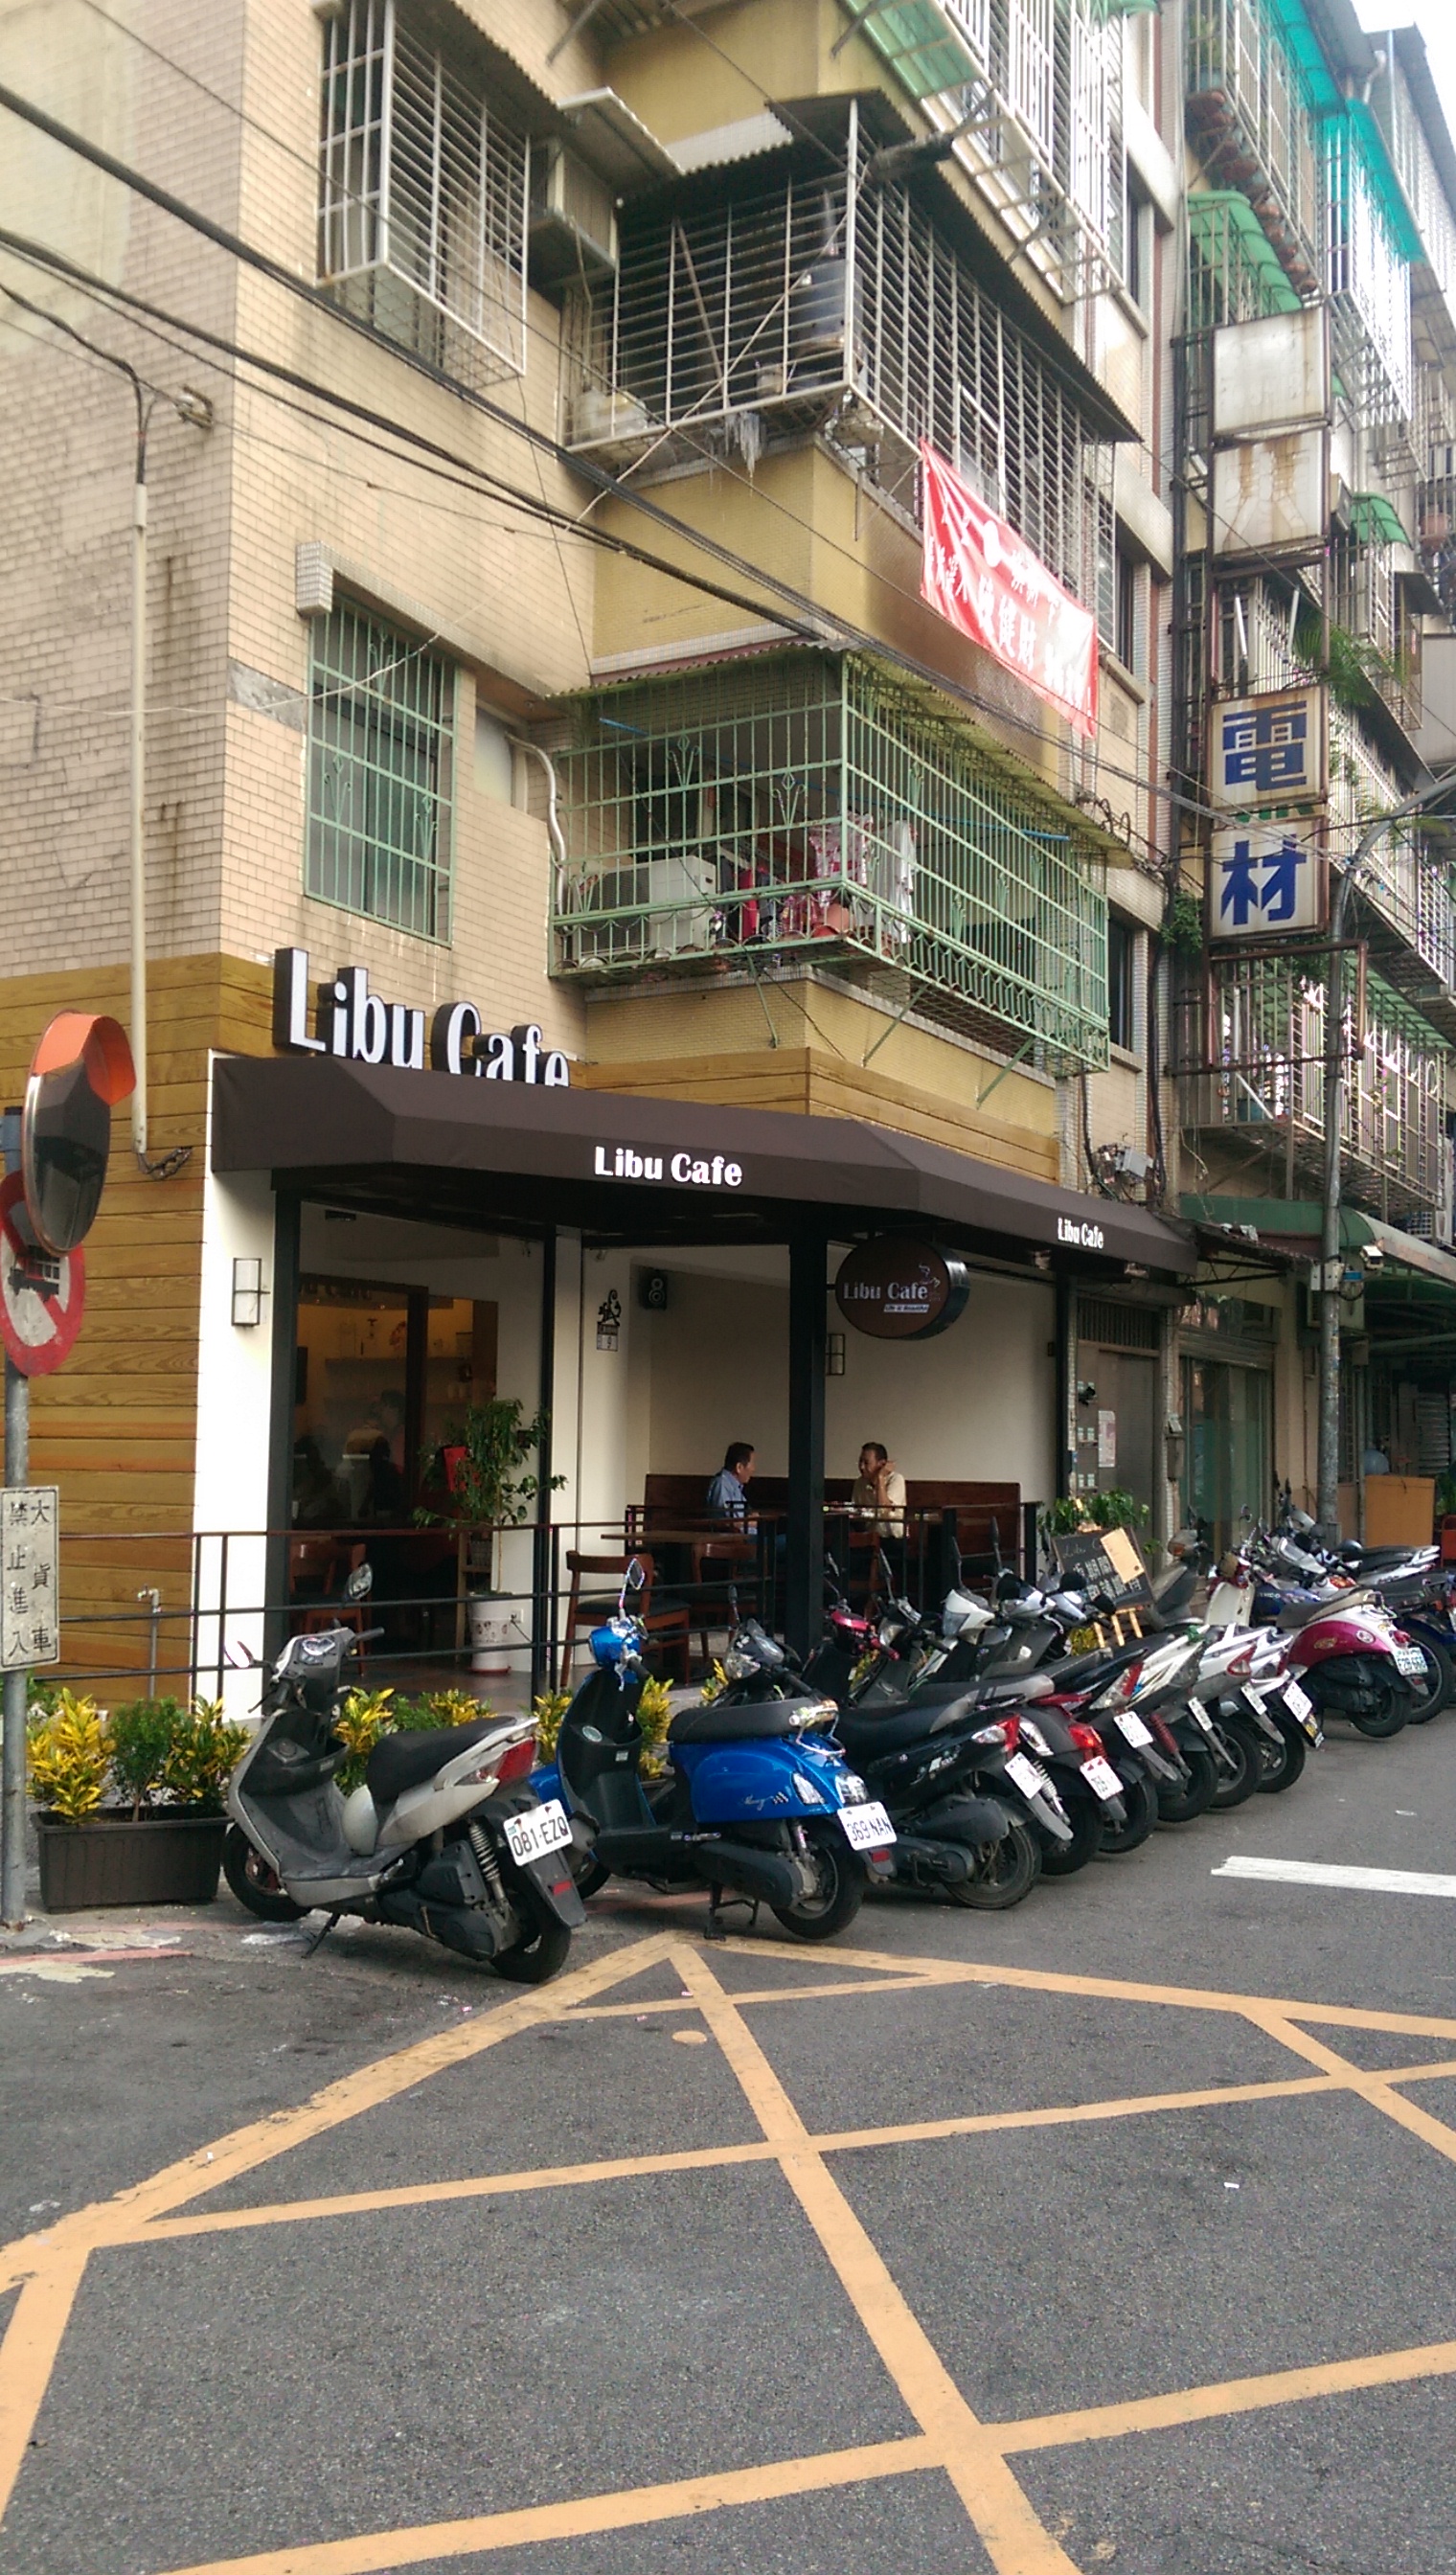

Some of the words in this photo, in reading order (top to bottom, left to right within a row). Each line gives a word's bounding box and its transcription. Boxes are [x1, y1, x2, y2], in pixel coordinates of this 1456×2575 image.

[273, 946, 426, 1070] Libu
[430, 1001, 570, 1087] Cafe
[594, 1146, 663, 1180] Libu
[671, 1152, 742, 1187] Cafe
[1058, 1217, 1080, 1244] Libu
[1081, 1222, 1104, 1249] Cafe
[843, 1281, 880, 1300] Libu
[887, 1282, 928, 1300] Cafe
[6, 1501, 30, 1658] 禁止進入
[31, 1499, 52, 1653] 大貨車
